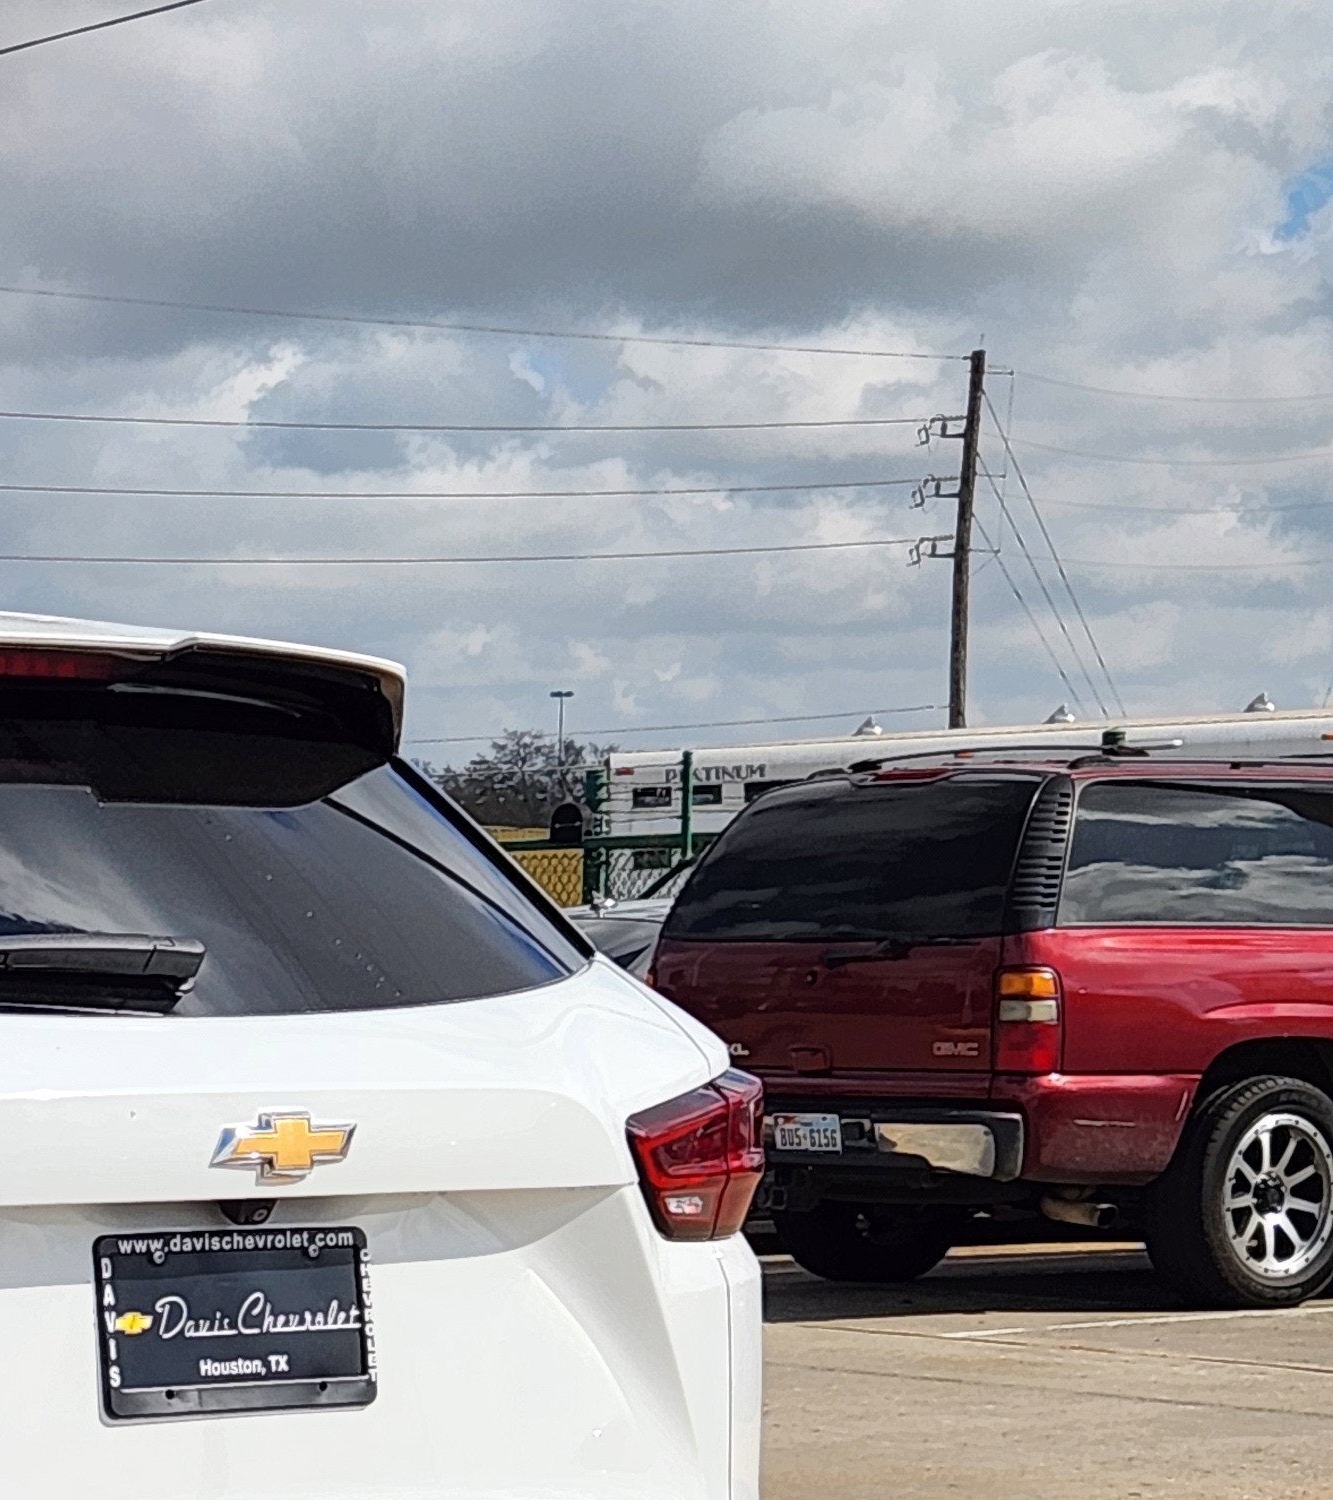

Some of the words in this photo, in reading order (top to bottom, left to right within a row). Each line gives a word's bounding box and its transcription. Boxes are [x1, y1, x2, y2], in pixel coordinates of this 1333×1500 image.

[933, 1042, 979, 1056] GMC
[118, 1230, 354, 1254] www.davischevrolet.com
[154, 1295, 237, 1339] Davis
[237, 1291, 362, 1334] Chevrolet
[199, 1356, 266, 1377] Houston,
[268, 1354, 289, 1372] TX
